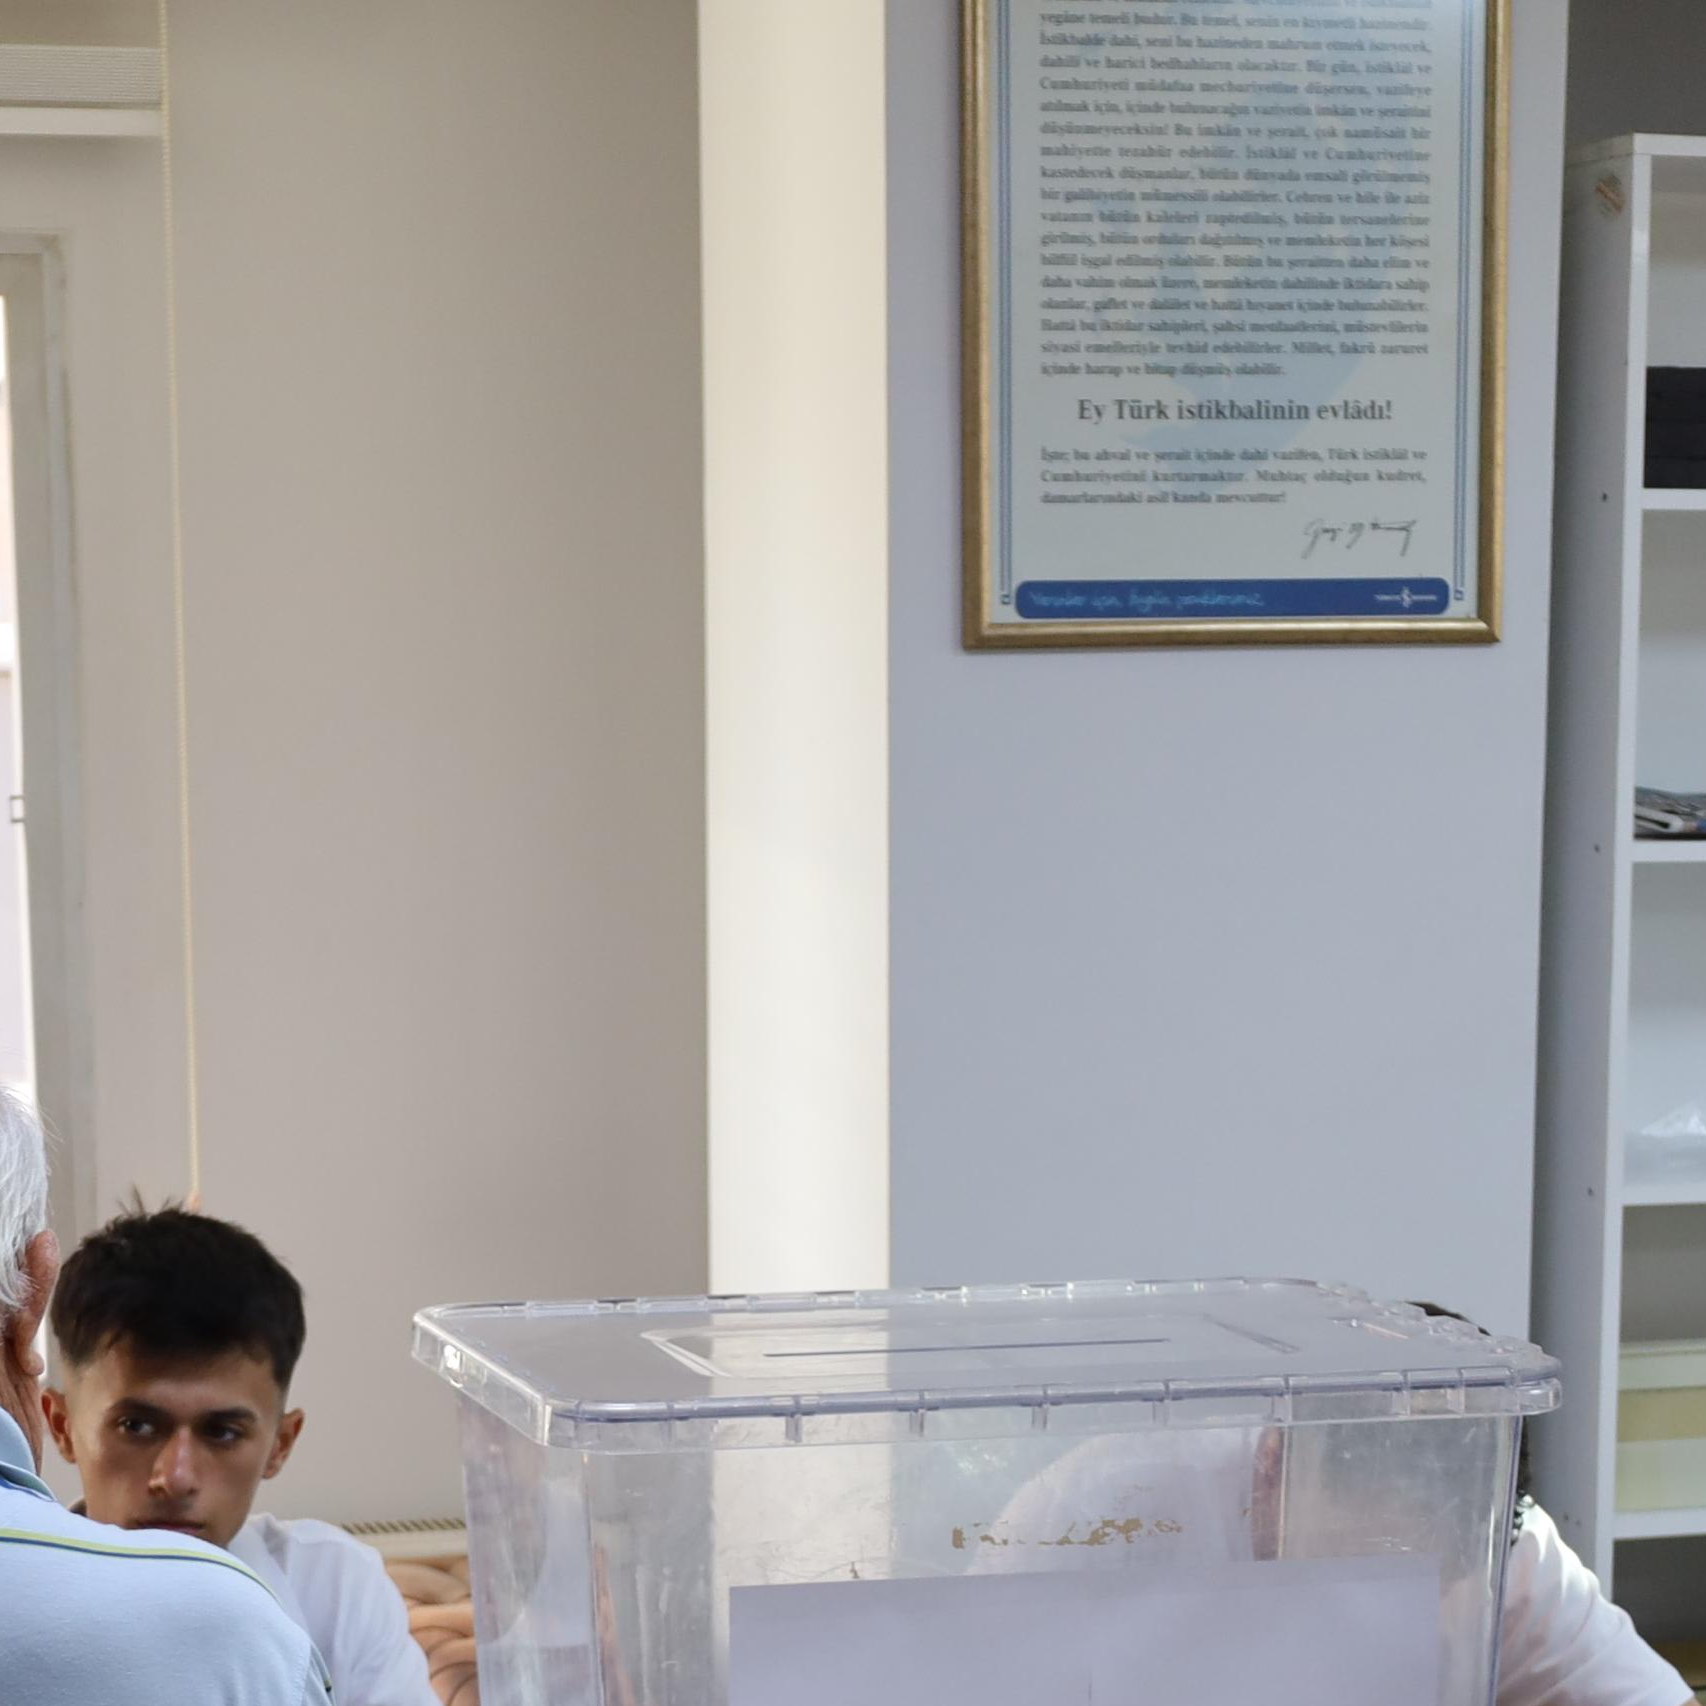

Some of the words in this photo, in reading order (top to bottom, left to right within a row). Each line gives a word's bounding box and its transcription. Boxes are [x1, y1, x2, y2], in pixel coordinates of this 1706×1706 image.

[1078, 399, 1104, 427] Ey
[1113, 397, 1170, 422] Türk
[1177, 397, 1311, 422] istikbalinin
[1316, 397, 1394, 422] evlâdı!
